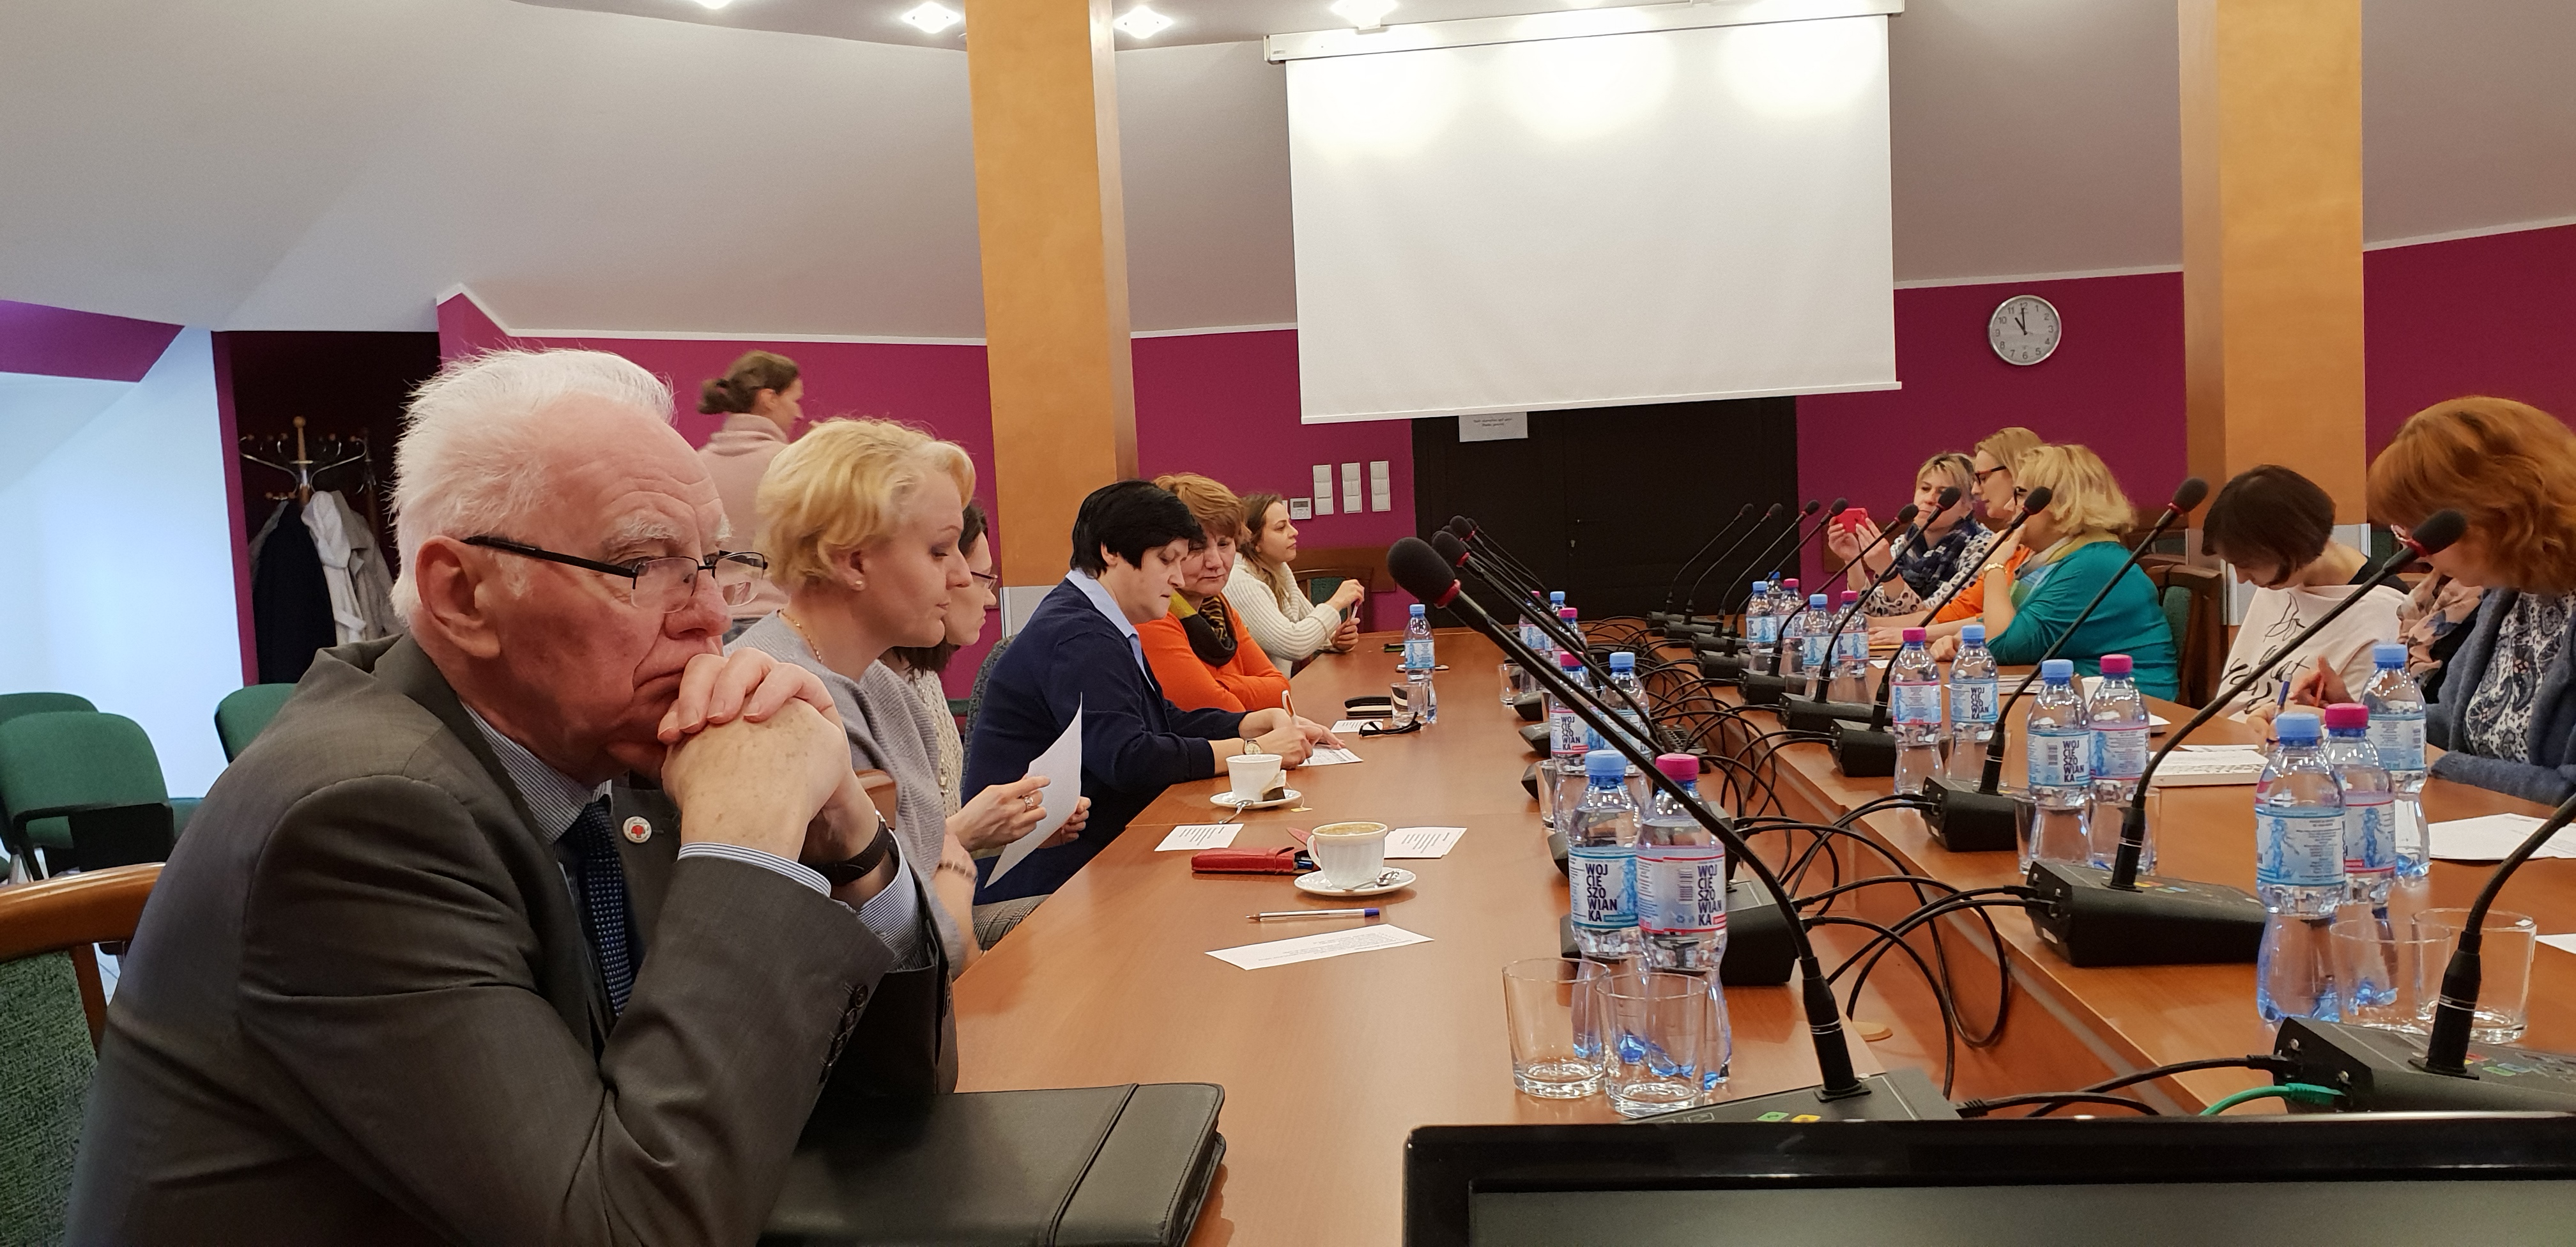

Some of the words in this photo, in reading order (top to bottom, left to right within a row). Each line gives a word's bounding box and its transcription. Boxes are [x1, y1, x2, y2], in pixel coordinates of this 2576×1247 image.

[1998, 316, 2007, 325] 10
[2000, 341, 2005, 349] 8
[2035, 348, 2041, 356] 5
[1971, 705, 1989, 714] WIAN
[1561, 735, 1581, 744] WIAN
[2062, 740, 2080, 749] WOJ
[2063, 749, 2075, 758] CIE
[2063, 757, 2078, 765] SZO
[2063, 764, 2085, 774] WIAN
[2064, 774, 2075, 783] KA
[1585, 863, 1608, 876] WOJ
[1697, 864, 1718, 878] WOJ
[1586, 875, 1602, 887] CIE
[1698, 876, 1713, 889] CIE
[1586, 887, 1607, 899] SZO
[1698, 889, 1715, 901] SZO
[1587, 898, 1618, 911] WIAN
[1698, 899, 1722, 914] WIAN
[1588, 910, 1602, 922] KA
[1698, 914, 1712, 926] KA
